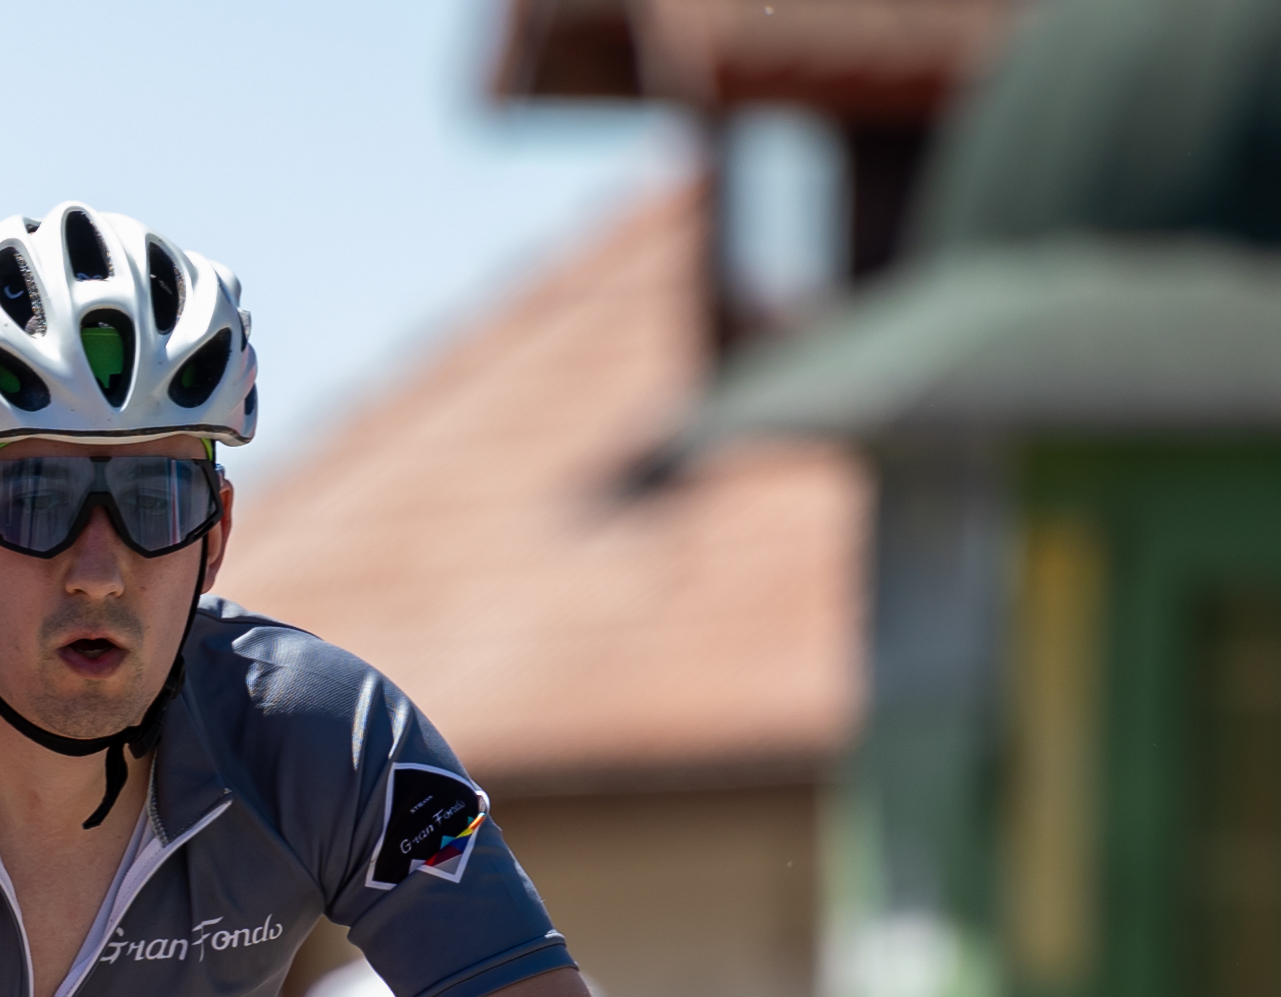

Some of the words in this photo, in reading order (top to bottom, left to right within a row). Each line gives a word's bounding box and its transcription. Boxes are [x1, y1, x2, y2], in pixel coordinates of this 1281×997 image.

[400, 824, 435, 855] Gran
[431, 800, 466, 825] Fondo
[99, 926, 189, 964] Gran
[191, 913, 284, 963] Fondo
